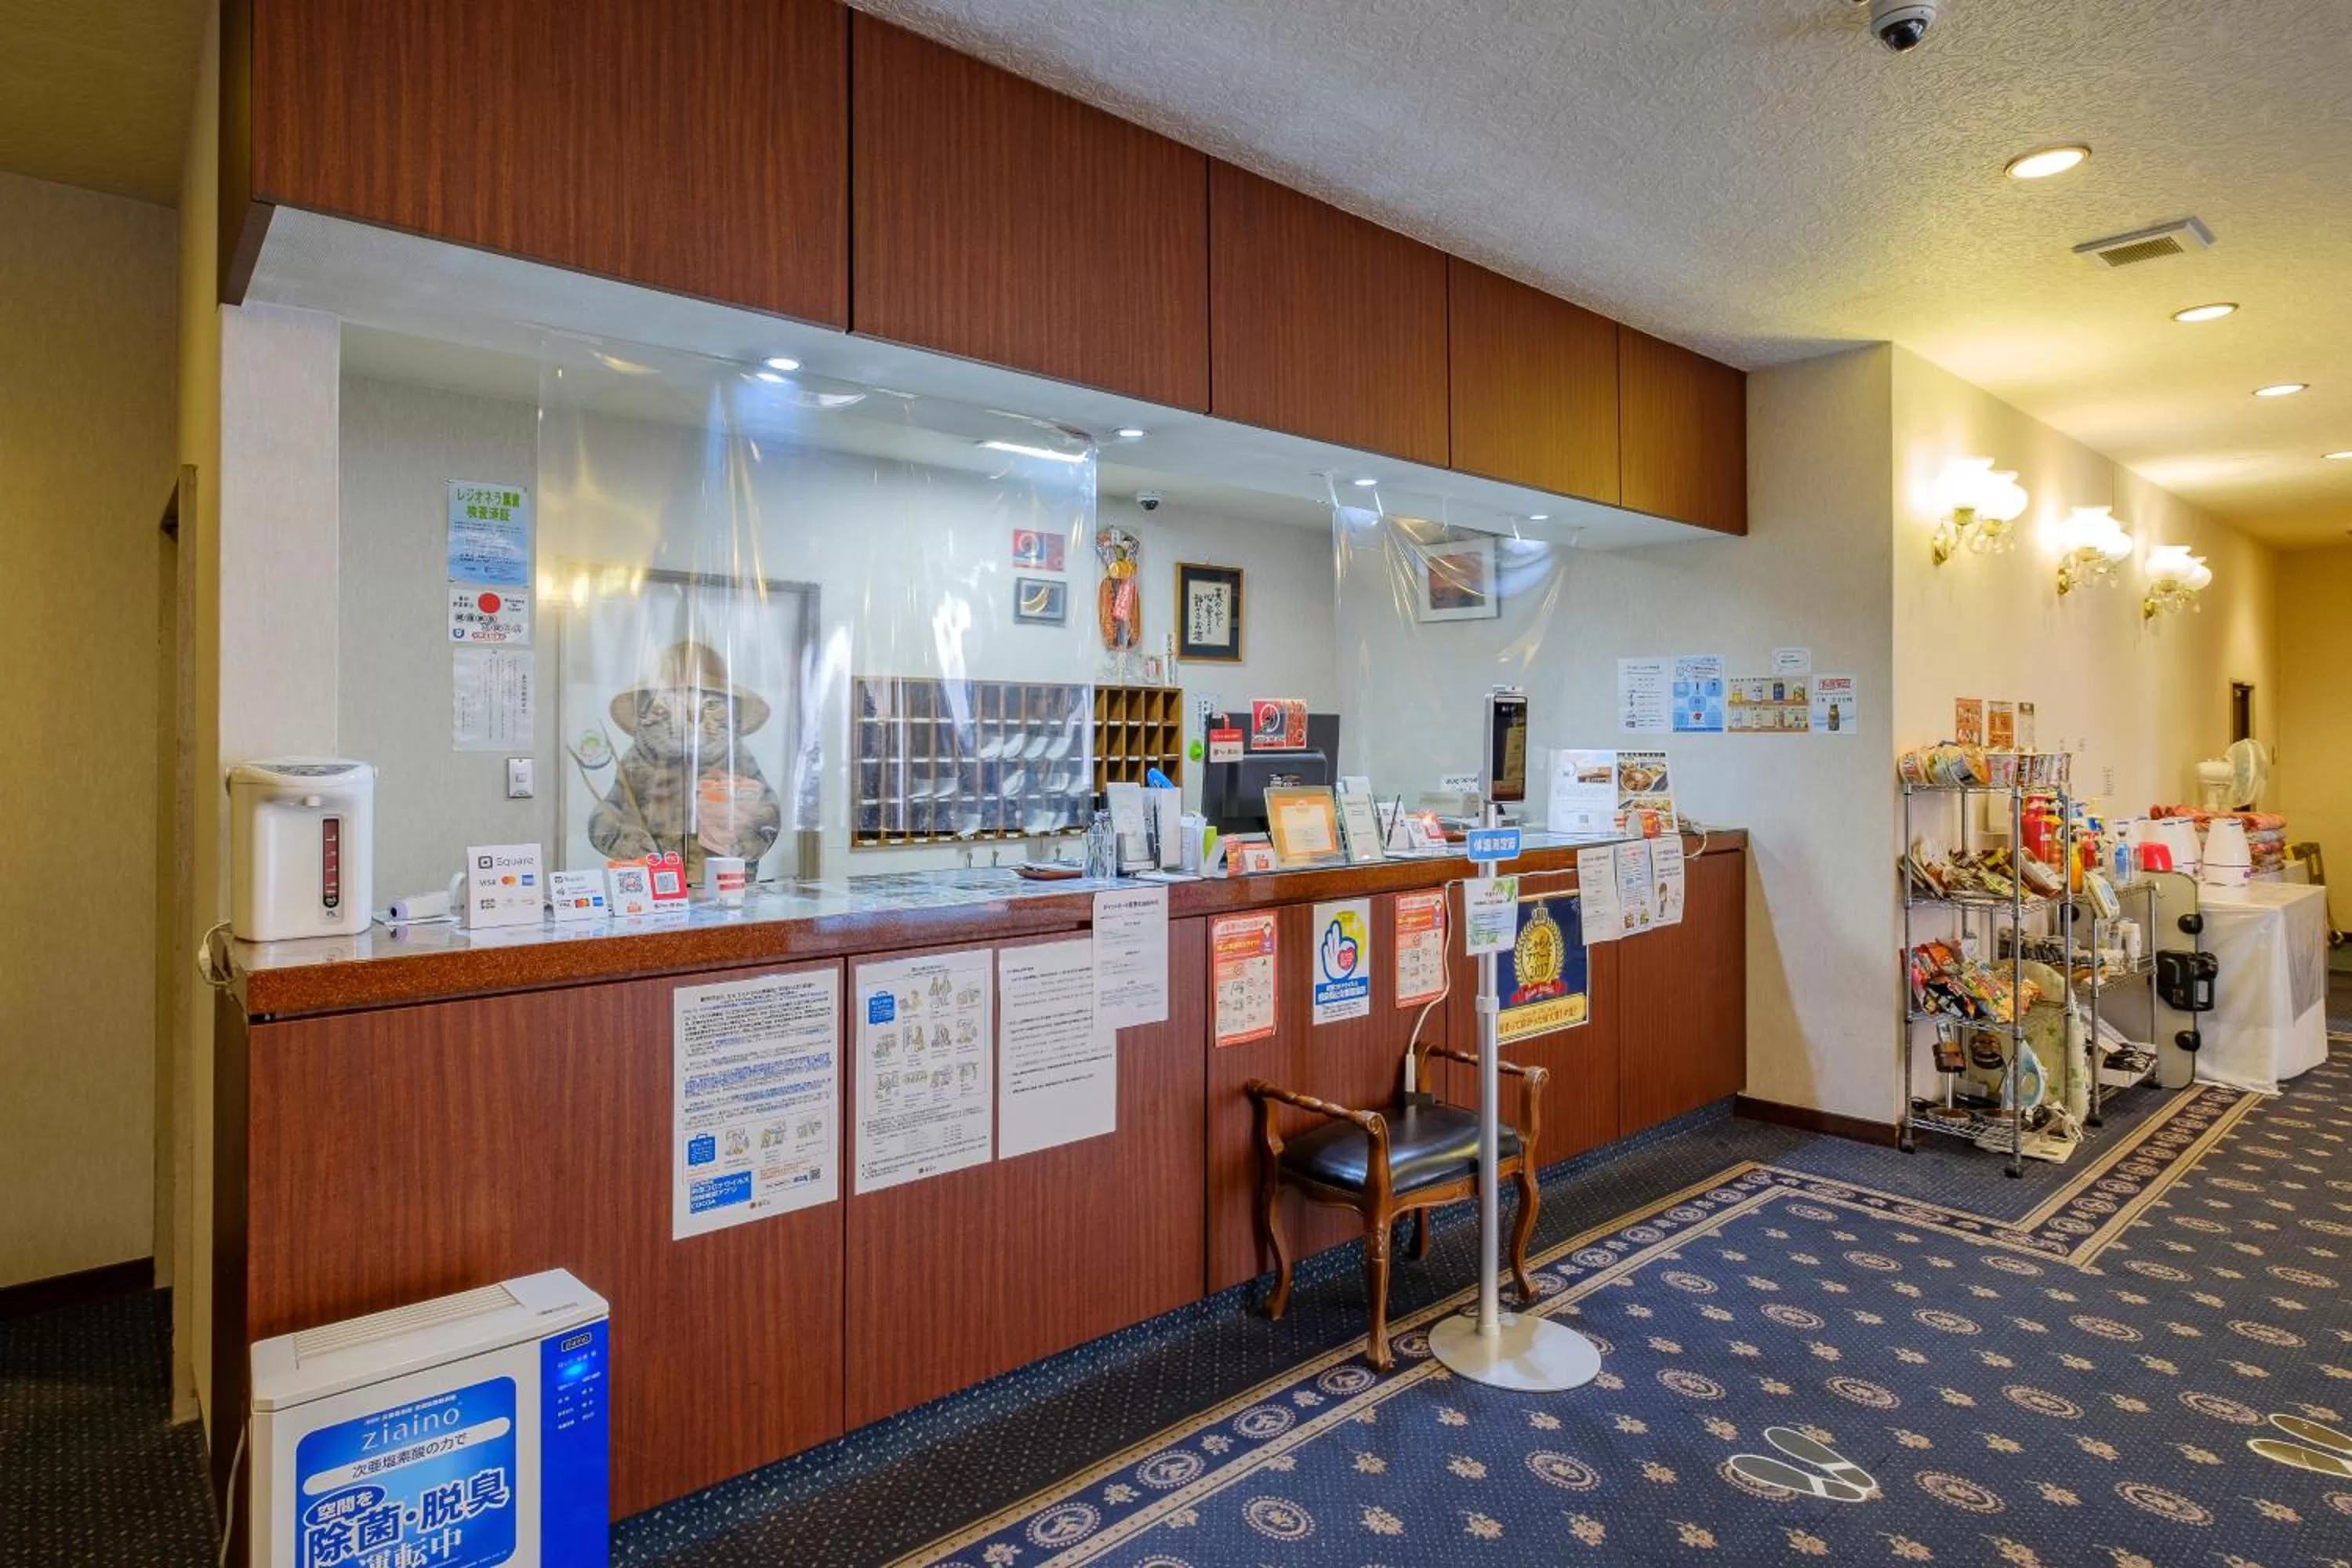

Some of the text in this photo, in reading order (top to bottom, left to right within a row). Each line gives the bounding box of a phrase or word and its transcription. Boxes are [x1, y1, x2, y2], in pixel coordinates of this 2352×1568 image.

[496, 856, 534, 867] Square
[362, 1407, 460, 1451] ziaino
[352, 1432, 470, 1479] 次亜塩素酸の力で
[308, 1469, 508, 1568] 除菌・脱臭
[317, 1490, 374, 1522] 空間を
